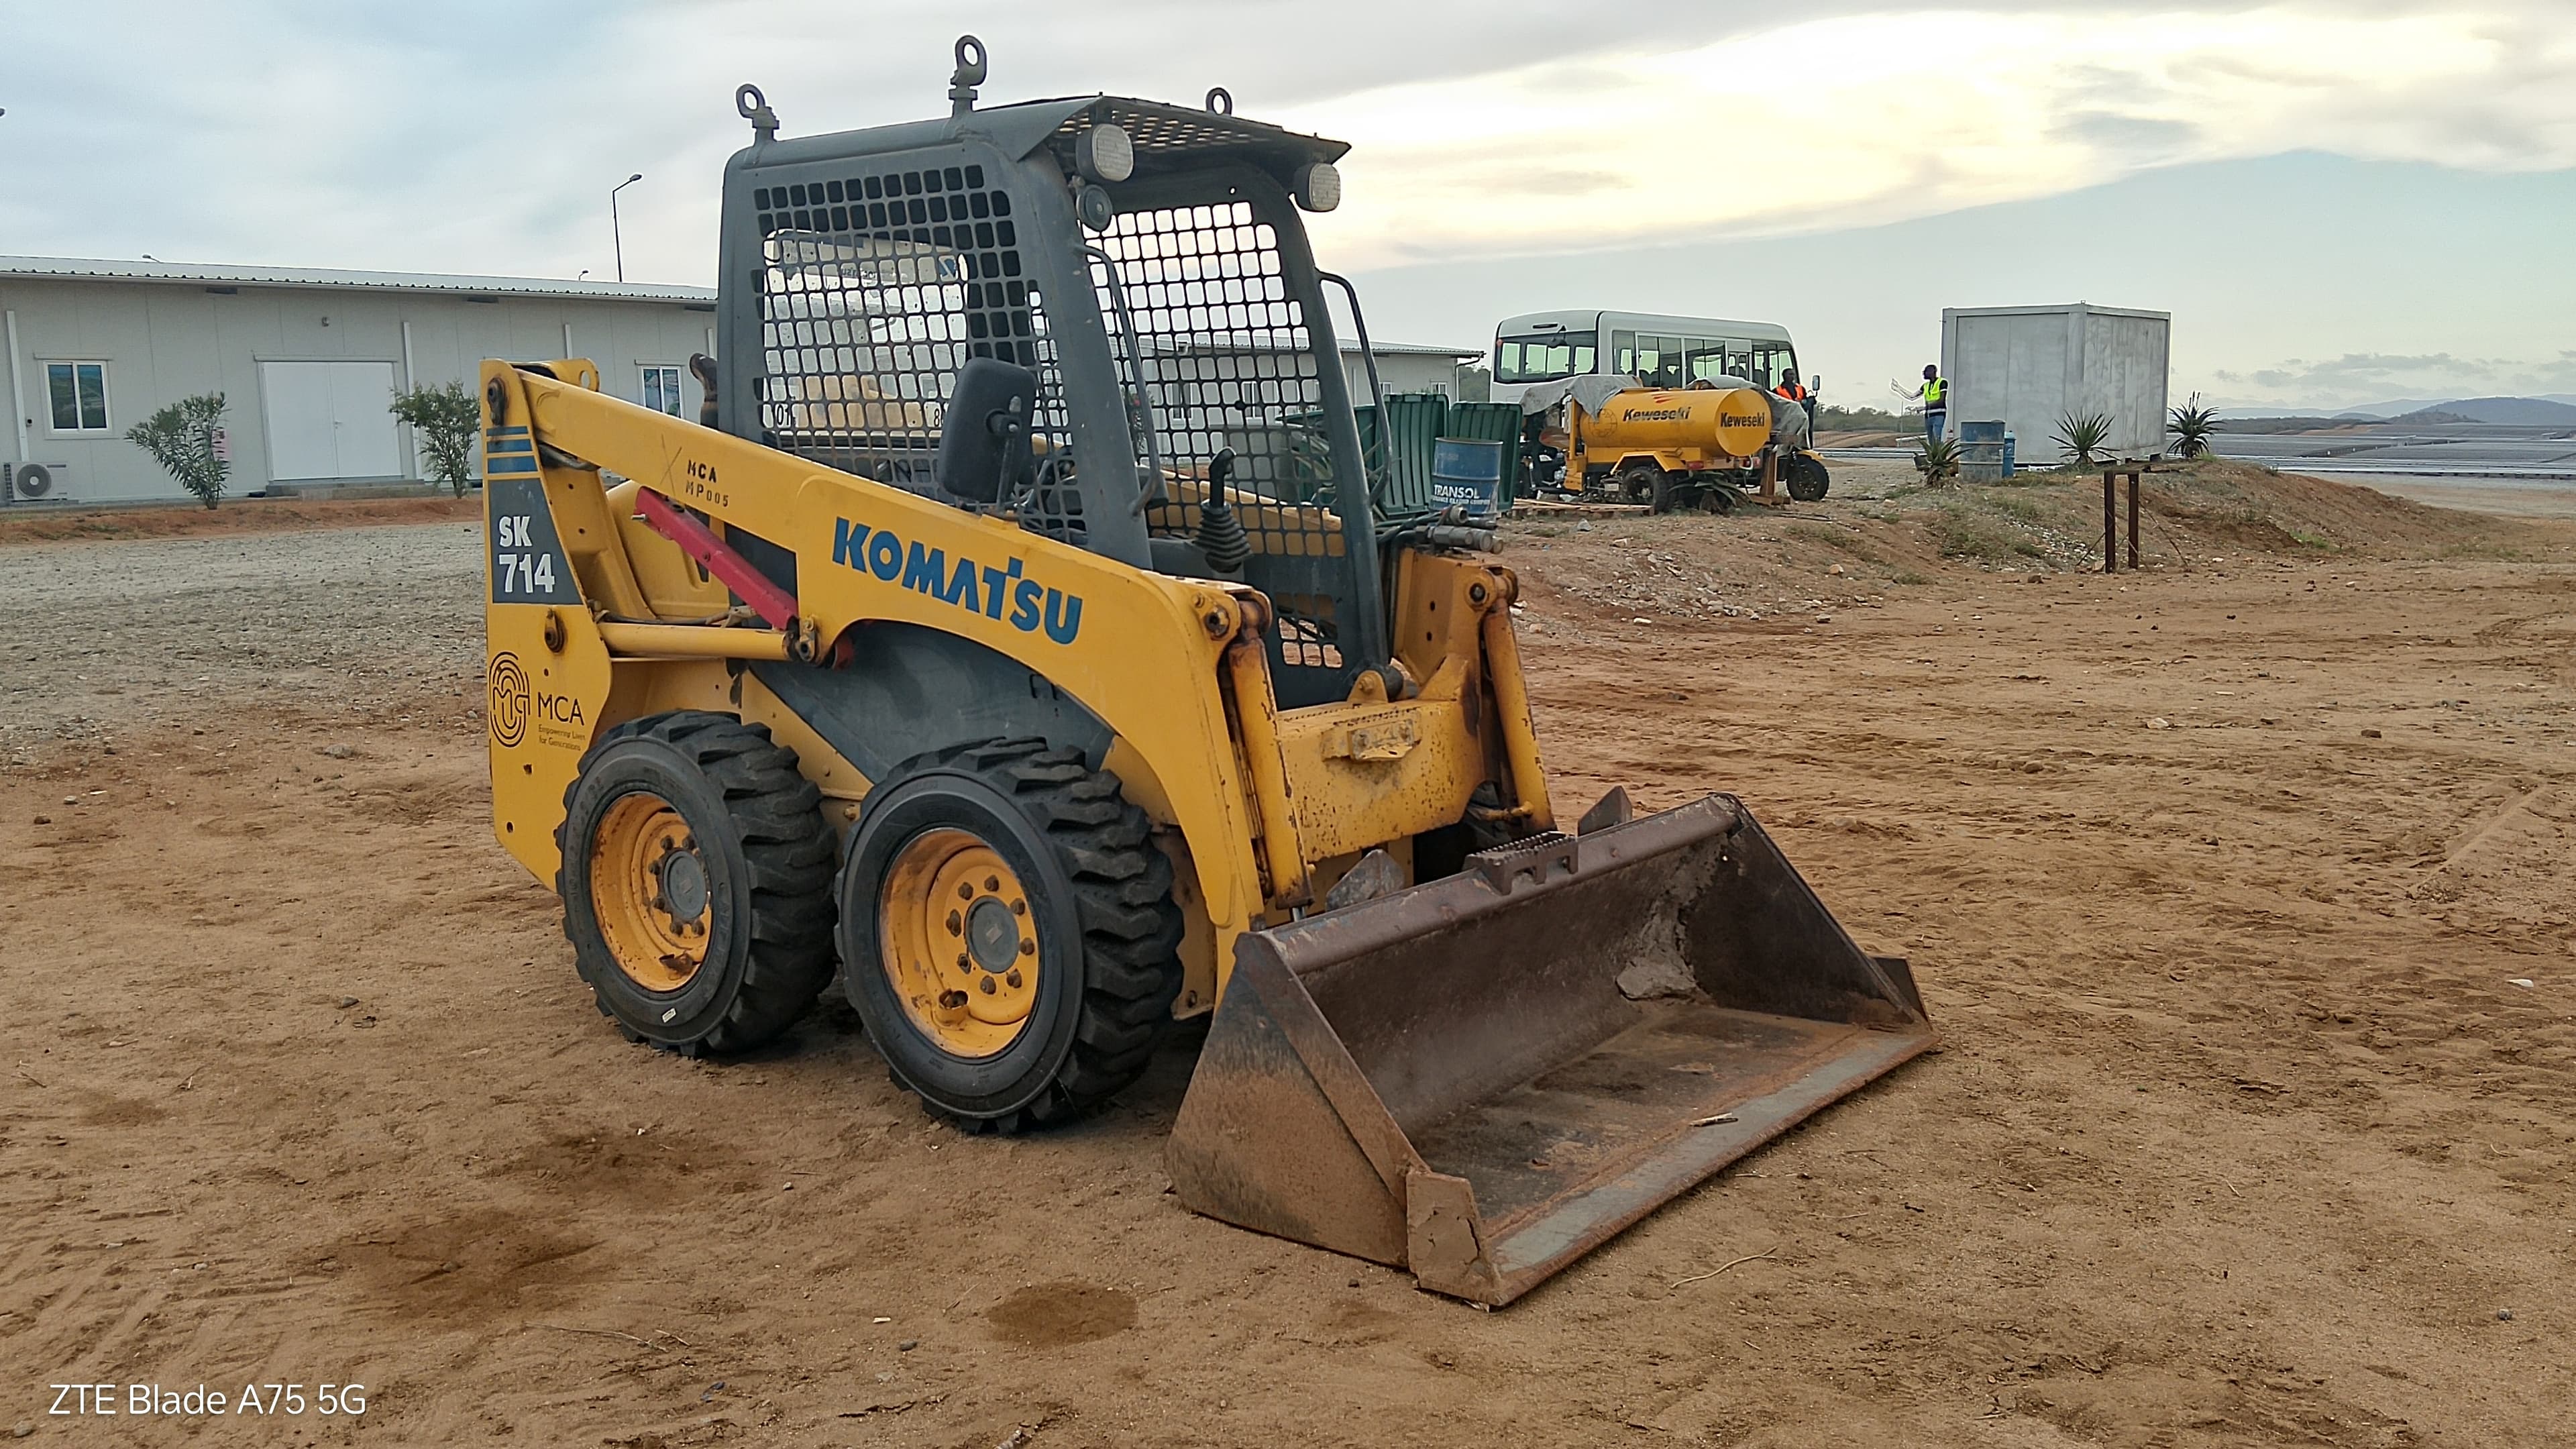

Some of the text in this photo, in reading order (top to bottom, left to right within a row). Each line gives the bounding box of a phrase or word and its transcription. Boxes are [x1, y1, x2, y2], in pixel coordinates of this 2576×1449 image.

[1623, 406, 1691, 421] Keweseki
[1720, 411, 1765, 428] Keweseki
[687, 459, 716, 483] MCA
[685, 480, 729, 507] MP005
[1434, 484, 1481, 500] TRANSOL
[498, 516, 533, 547] SK
[498, 553, 555, 593] 714
[833, 517, 1083, 645] KOMATSU
[537, 692, 584, 726] MCA
